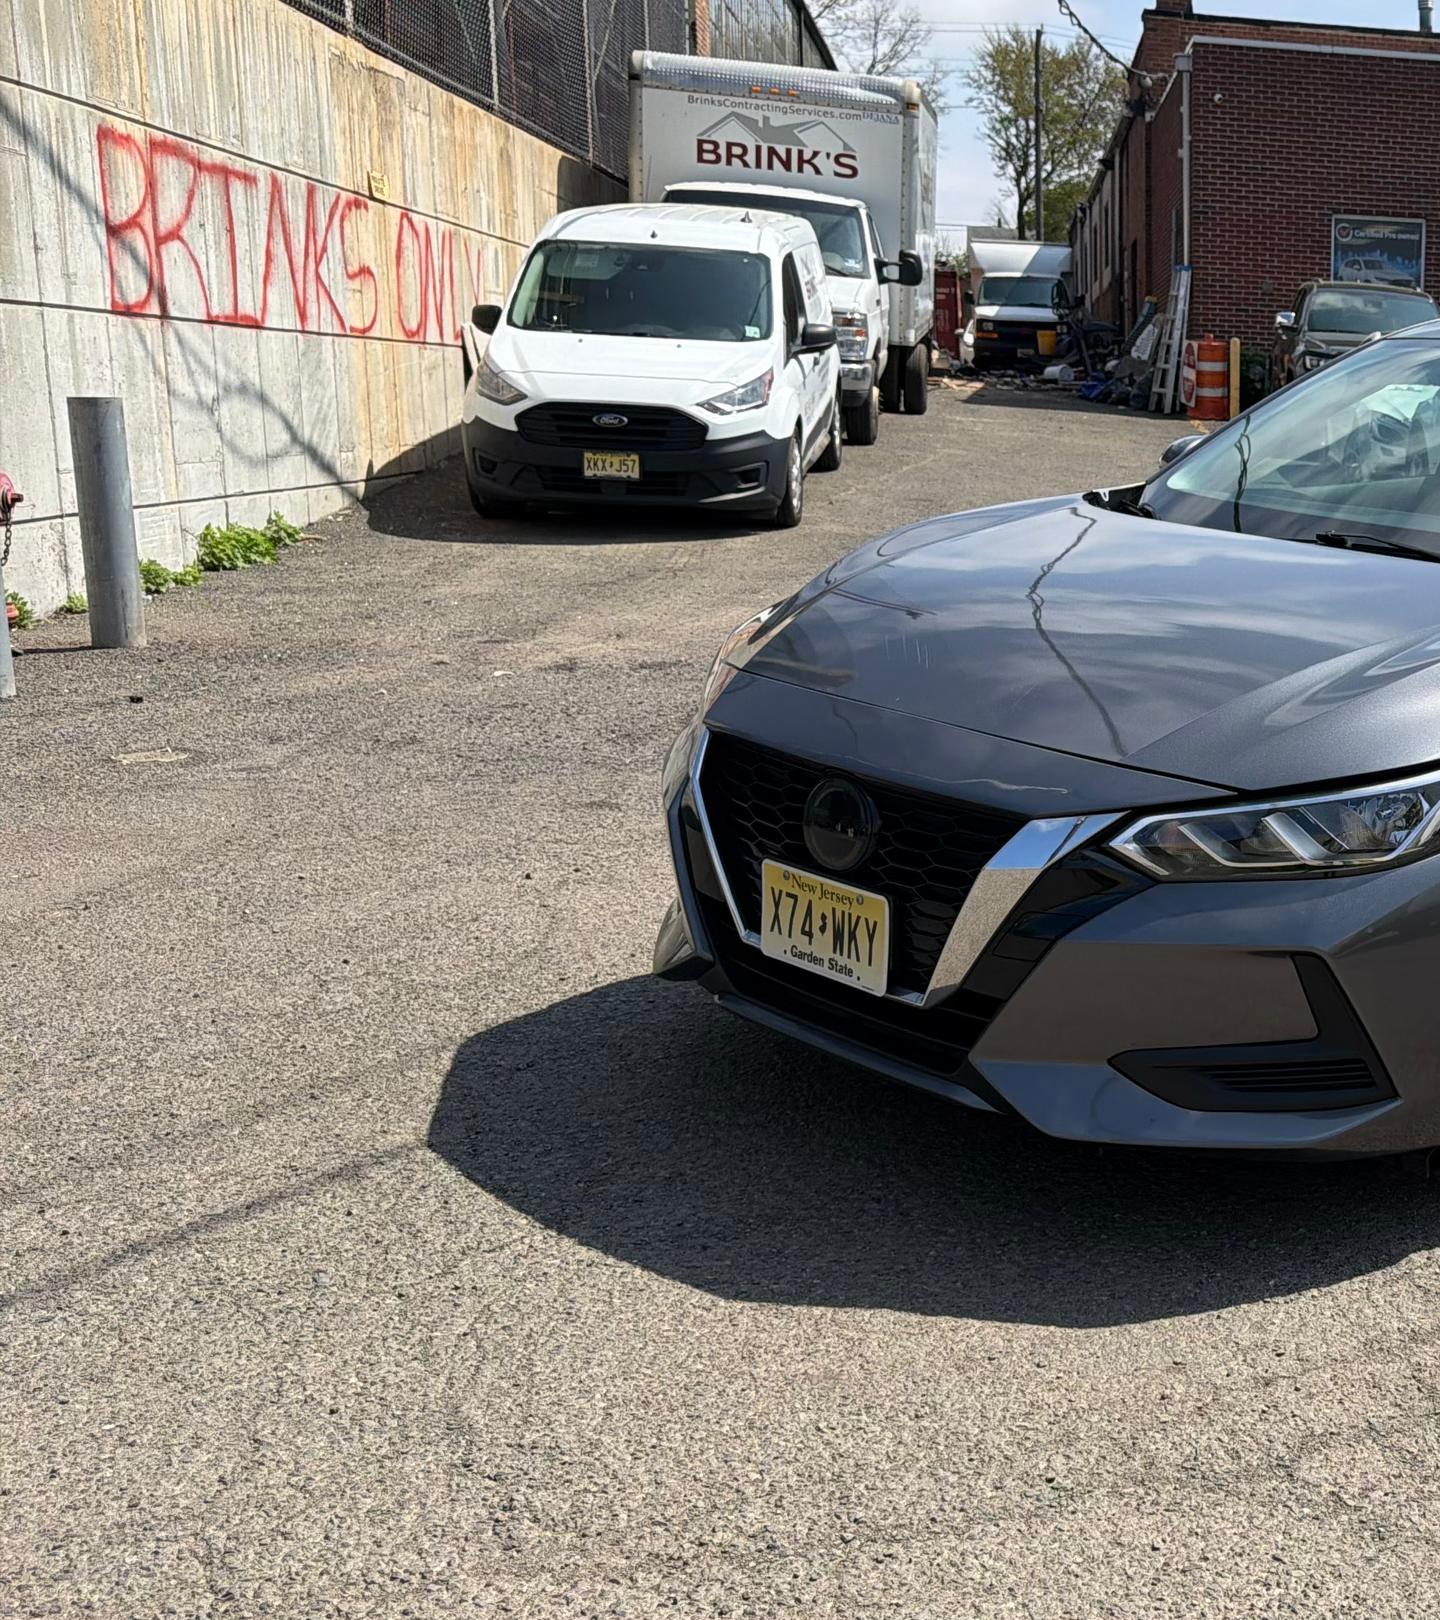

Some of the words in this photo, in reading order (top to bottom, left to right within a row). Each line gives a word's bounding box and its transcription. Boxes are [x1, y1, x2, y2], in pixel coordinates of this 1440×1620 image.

[687, 95, 862, 121] BrinksContractingServices.com
[696, 138, 859, 179] BRINK'S
[96, 123, 379, 336] BRINKS
[791, 873, 817, 894] New
[818, 883, 855, 909] Jersey
[790, 945, 825, 968] Garden
[827, 957, 854, 978] State
